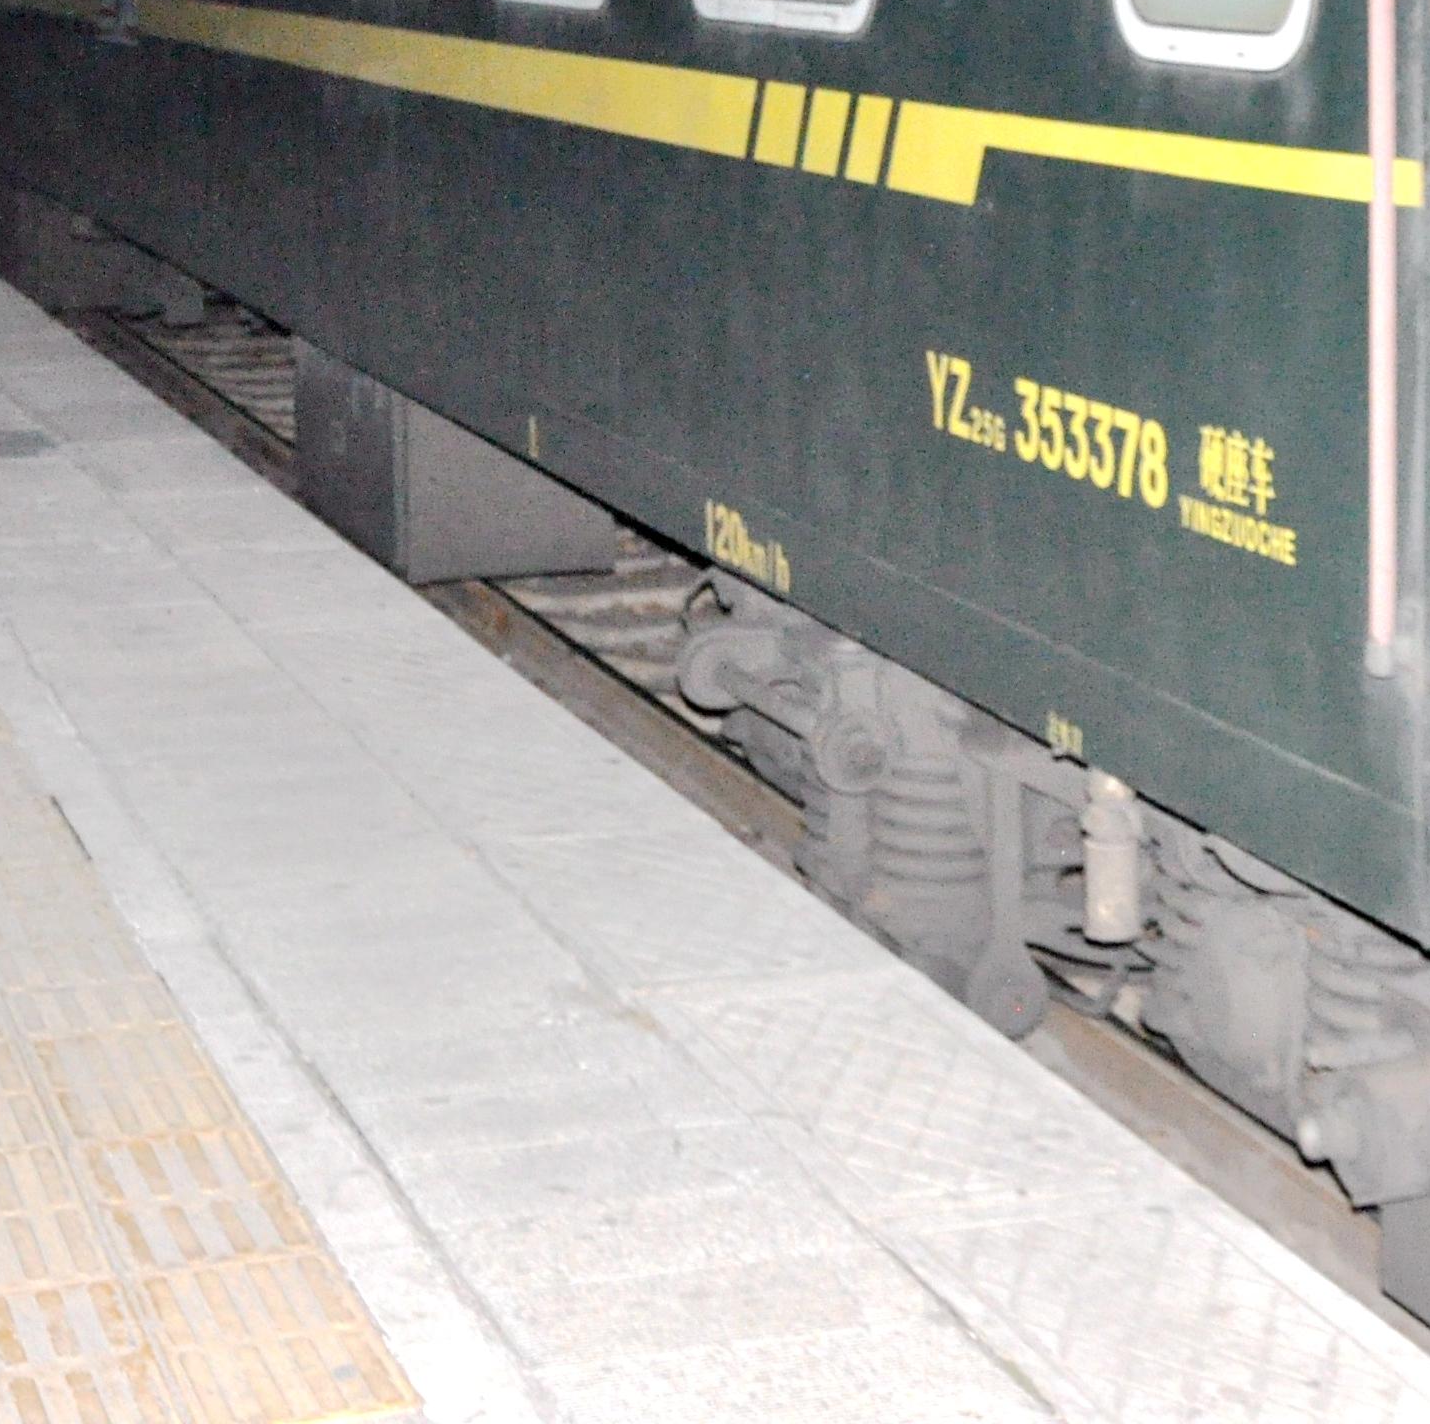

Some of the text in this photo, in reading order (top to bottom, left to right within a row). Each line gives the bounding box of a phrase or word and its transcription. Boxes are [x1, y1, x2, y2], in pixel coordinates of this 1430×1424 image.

[1014, 376, 1169, 509] 353378
[1198, 424, 1275, 515] 硬座车
[1178, 494, 1298, 566] YINGZUOCHE
